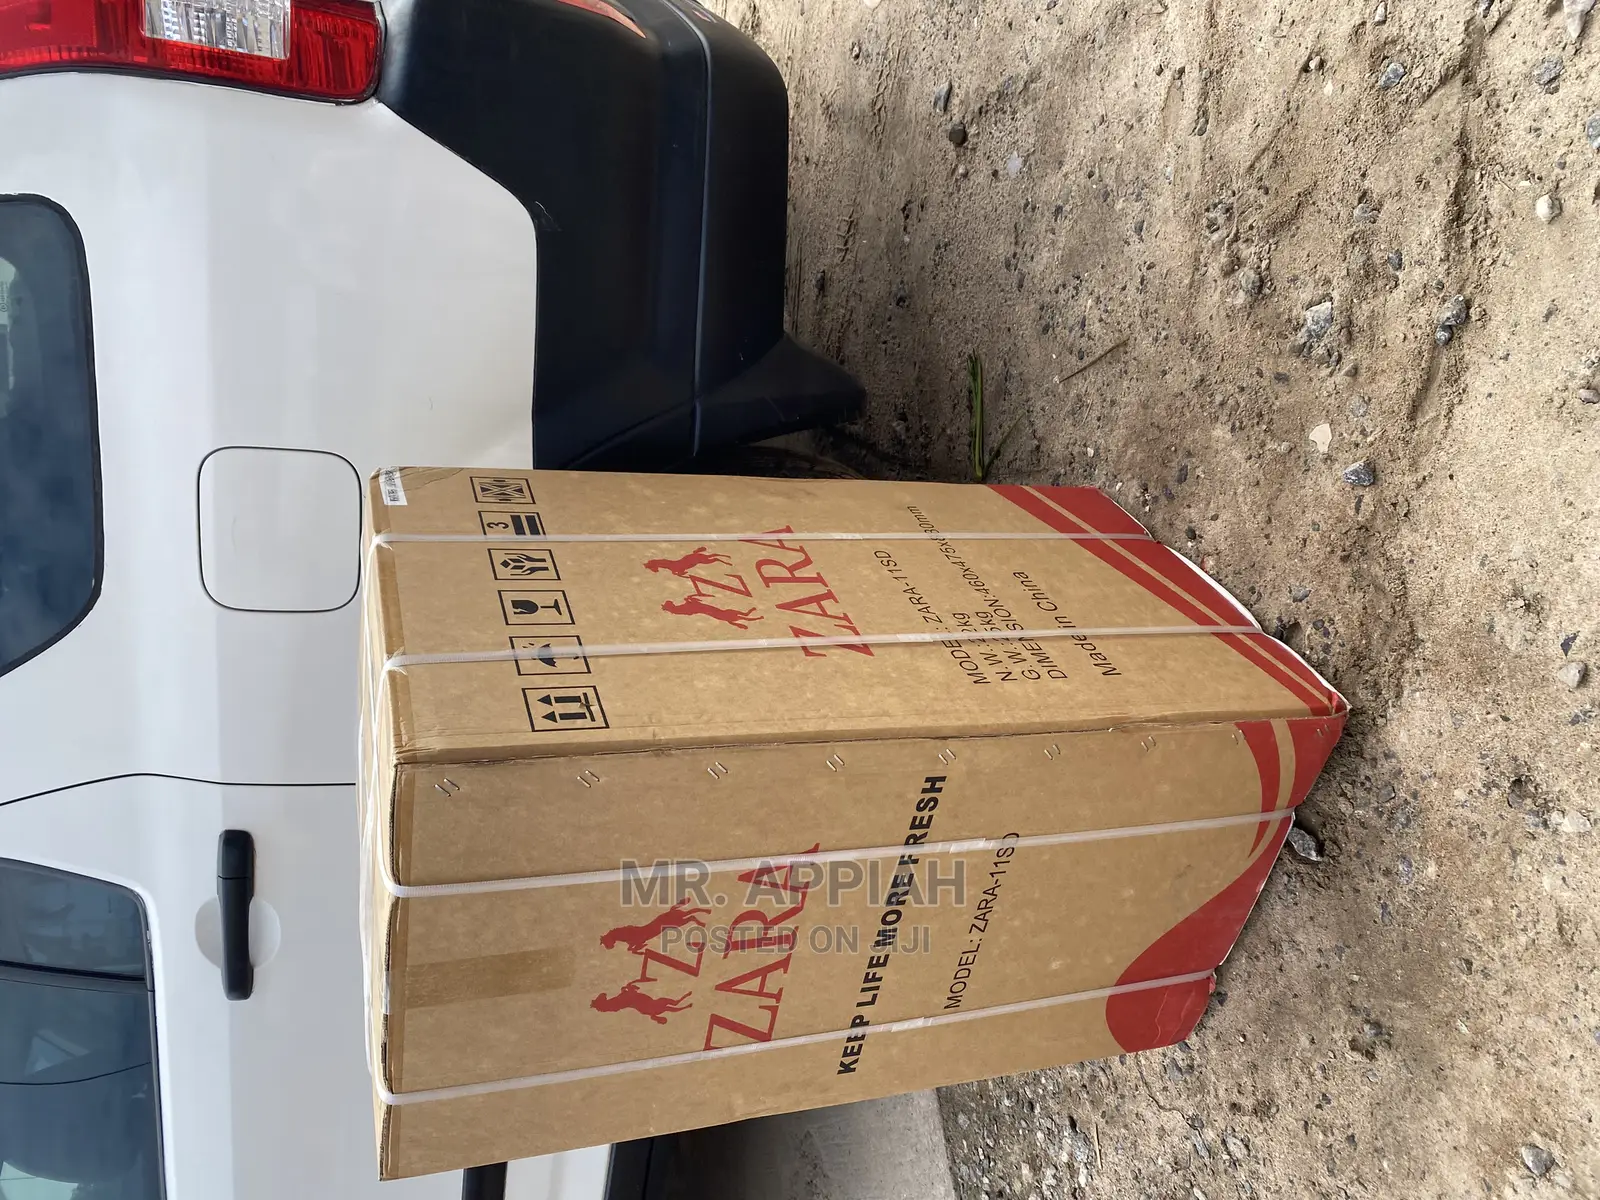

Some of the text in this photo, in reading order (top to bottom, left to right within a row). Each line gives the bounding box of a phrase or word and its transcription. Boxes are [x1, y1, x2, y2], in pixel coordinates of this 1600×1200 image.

[486, 521, 509, 530] 3
[737, 524, 875, 657] ZARA
[873, 550, 991, 685] MODE: ZARA-11SD
[1012, 571, 1122, 676] Made in China
[702, 842, 821, 1051] ZARA
[836, 775, 948, 1075] KEEP LIFE MORE FRESH
[943, 832, 1021, 1010] MODEL: ZARA-11SD
